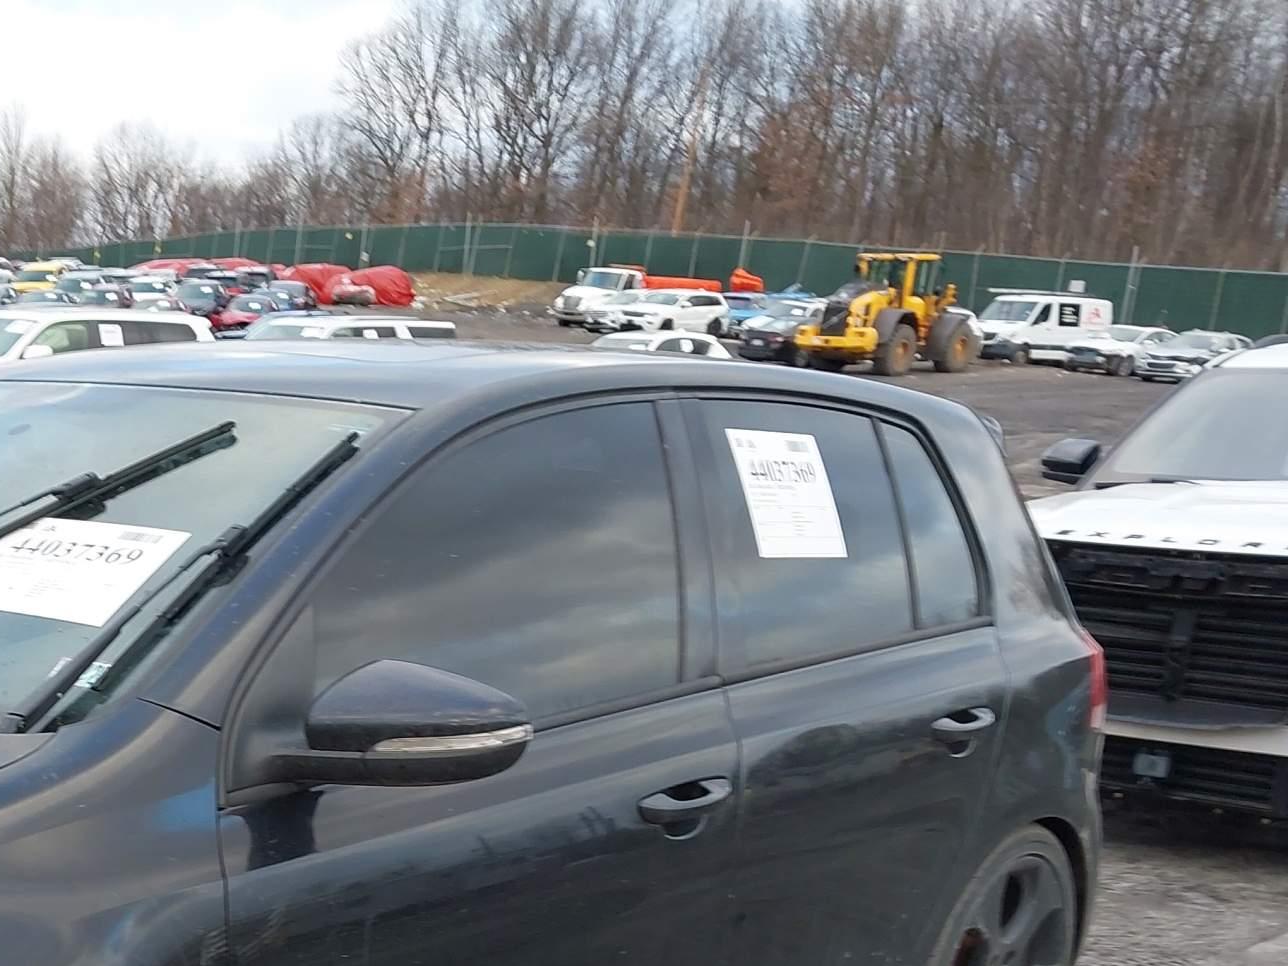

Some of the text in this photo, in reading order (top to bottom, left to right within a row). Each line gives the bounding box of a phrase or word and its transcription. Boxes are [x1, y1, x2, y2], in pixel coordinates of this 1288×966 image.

[749, 460, 817, 483] 44037369
[10, 538, 144, 564] 44037369
[1055, 529, 1288, 550] EXPLOR
